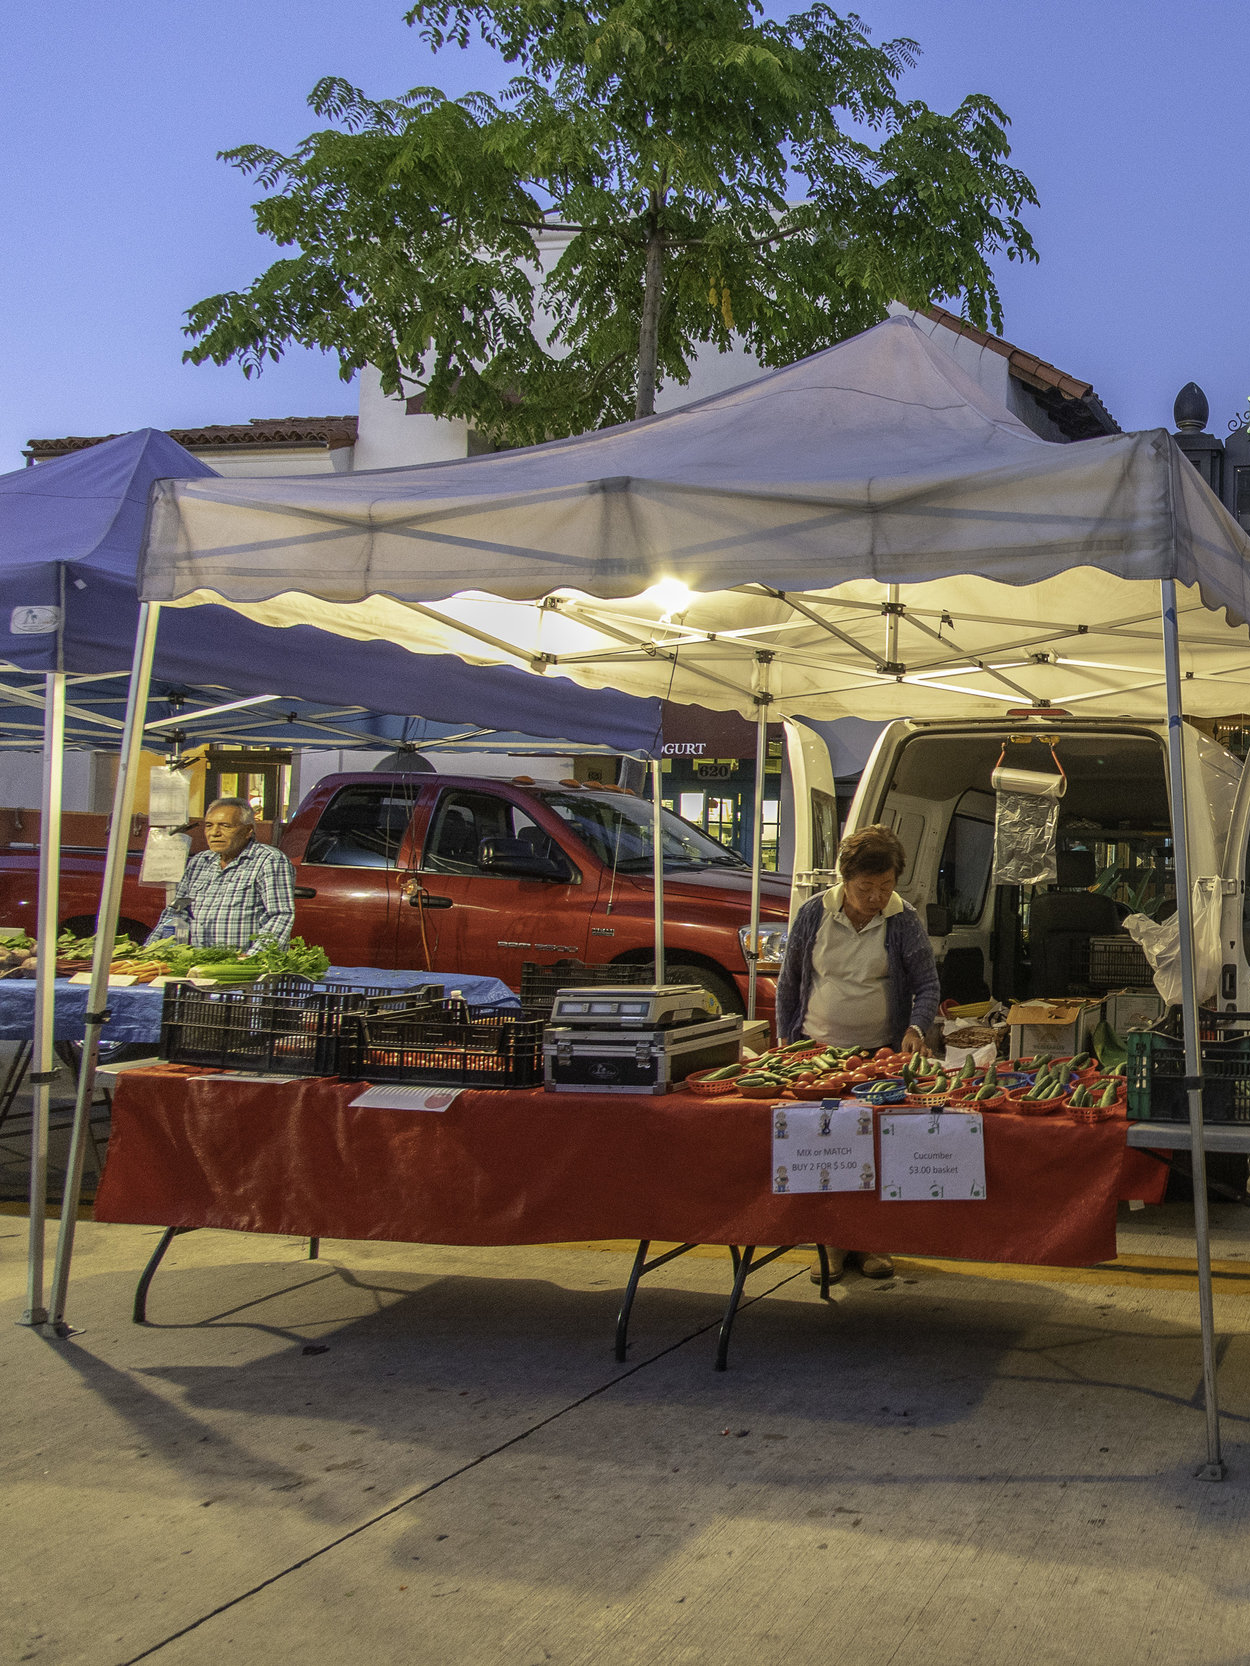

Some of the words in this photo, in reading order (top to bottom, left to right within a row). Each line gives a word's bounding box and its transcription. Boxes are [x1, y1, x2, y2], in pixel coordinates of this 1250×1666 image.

[661, 743, 706, 755] GURT
[699, 765, 729, 777] 620
[796, 1149, 812, 1157] MIX
[823, 1147, 852, 1156] MATCH
[913, 1152, 953, 1160] Cucumber
[792, 1163, 808, 1171] BUY
[816, 1162, 832, 1170] FOR
[909, 1166, 931, 1175] $3.00
[932, 1165, 959, 1174] basket
